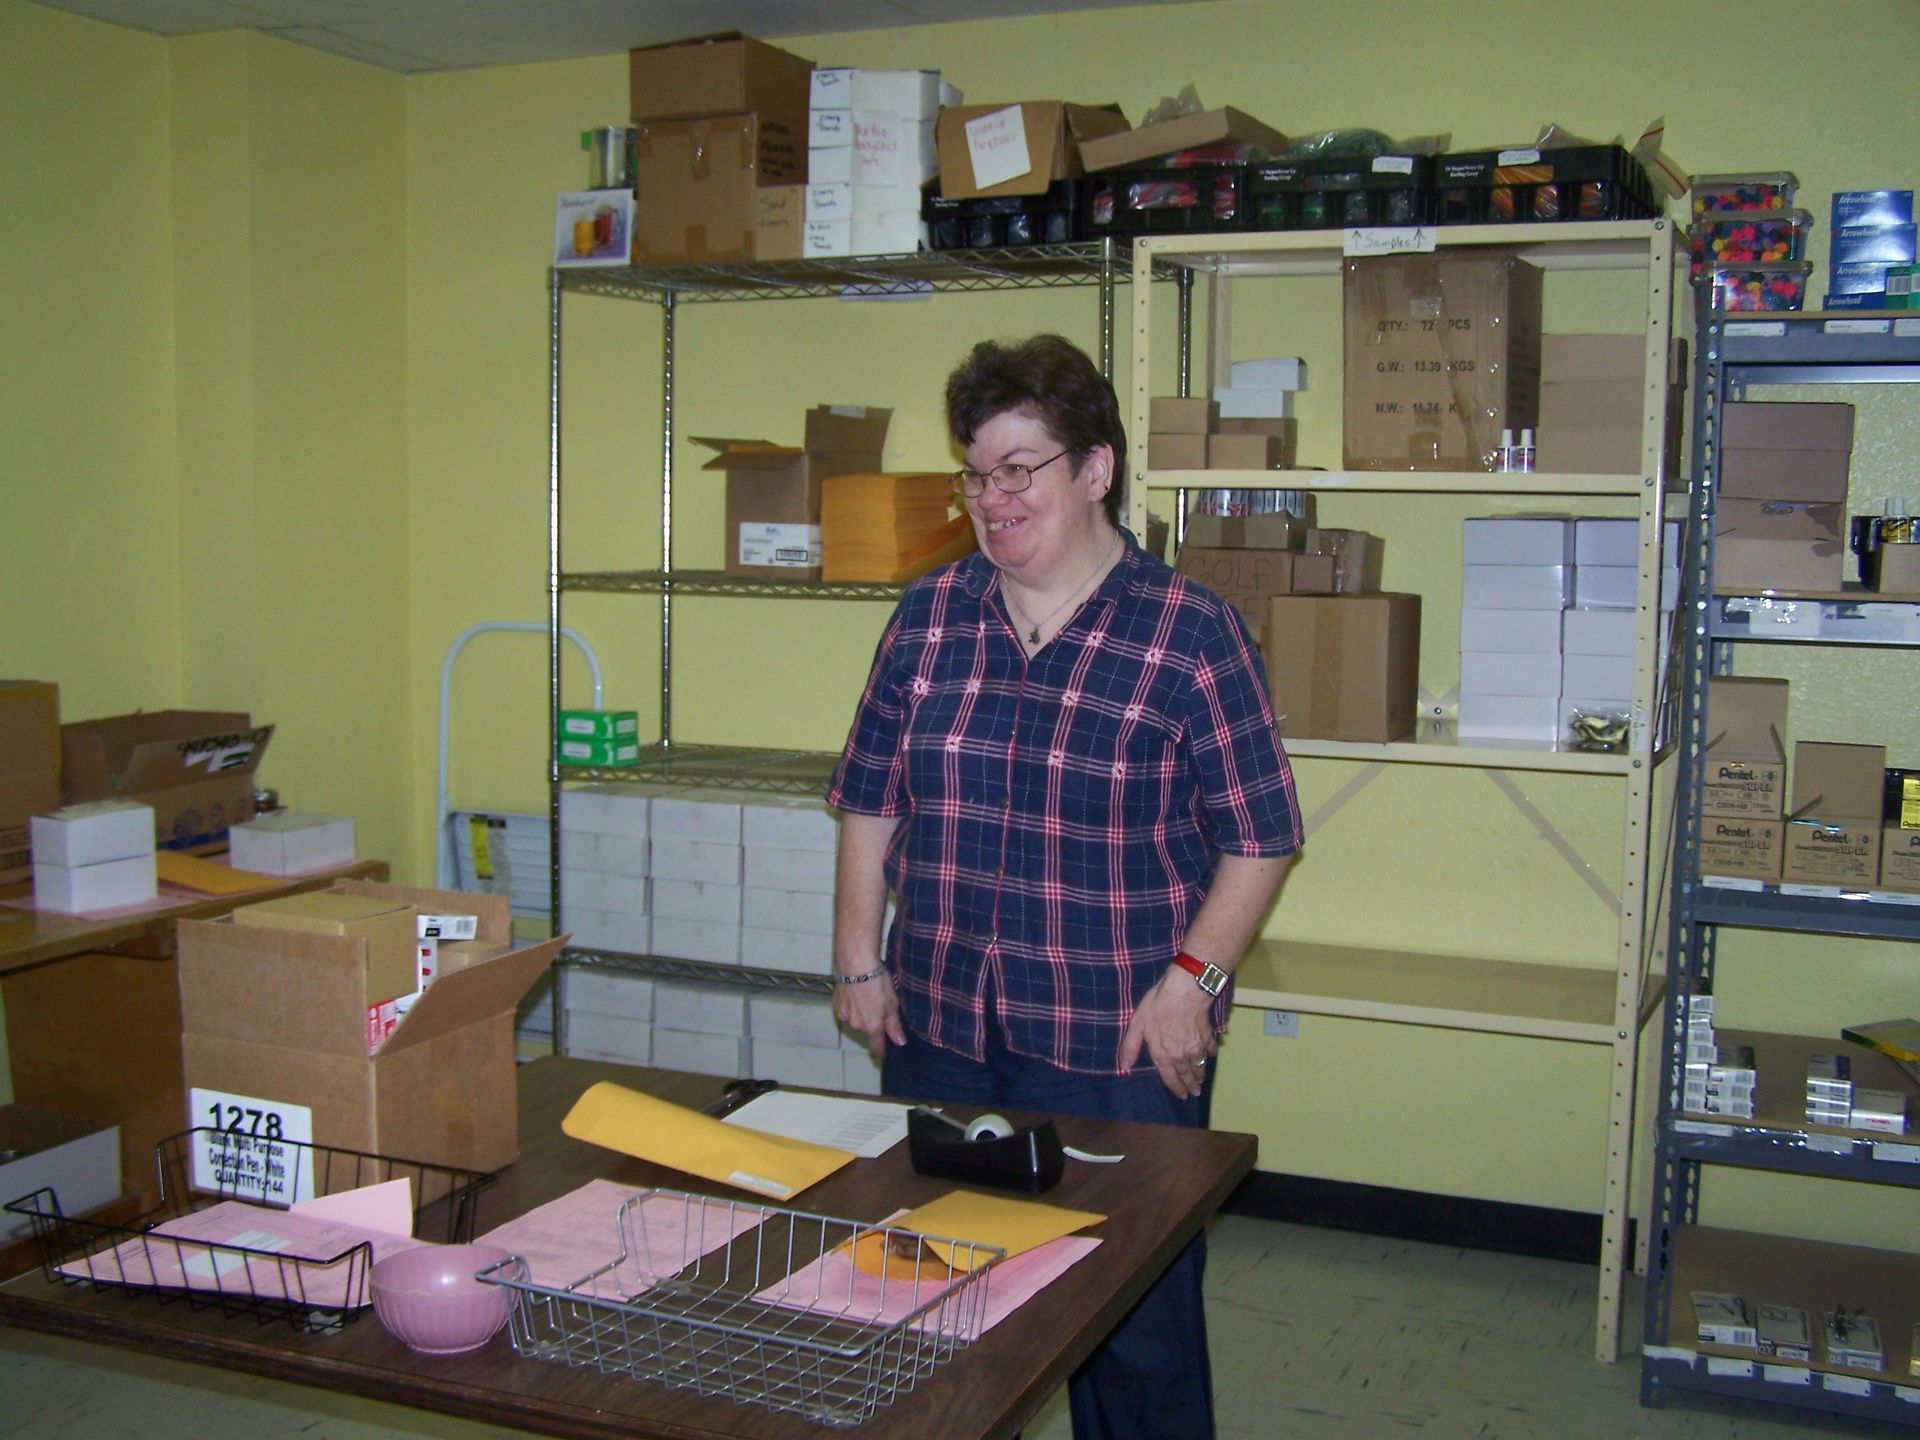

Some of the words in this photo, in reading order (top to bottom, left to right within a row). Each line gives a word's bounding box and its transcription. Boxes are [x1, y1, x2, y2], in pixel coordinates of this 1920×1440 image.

[1365, 231, 1410, 250] Samples
[1448, 319, 1470, 330] PCS
[1414, 361, 1441, 372] 13.39
[1449, 360, 1474, 372] KGS
[1719, 767, 1754, 780] Pentel
[1716, 824, 1751, 837] Pentel
[1812, 830, 1848, 843] Pentel
[209, 1102, 284, 1140] 1278
[247, 1154, 259, 1173] Pen
[267, 1179, 284, 1194] 144
